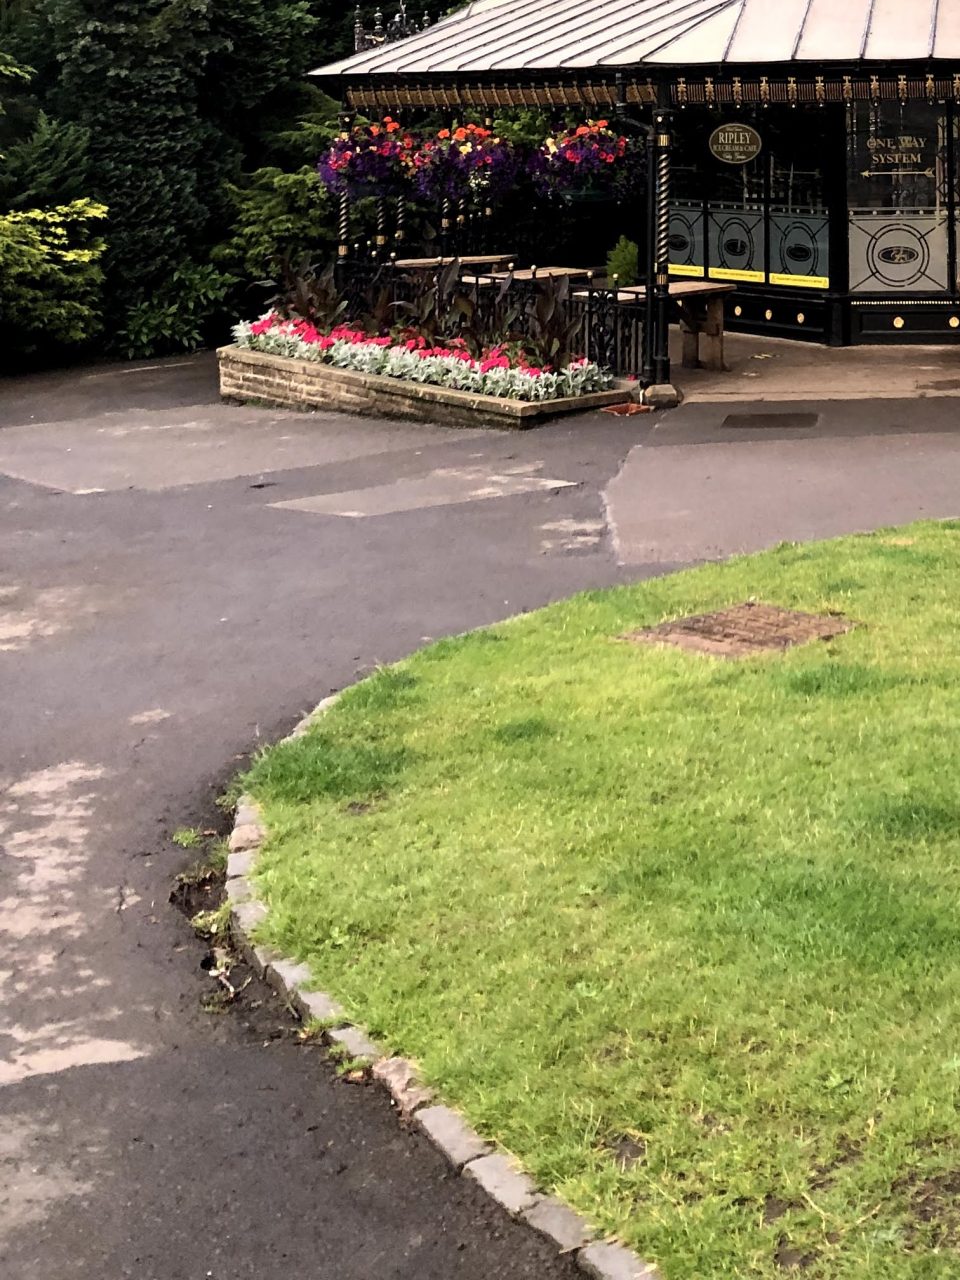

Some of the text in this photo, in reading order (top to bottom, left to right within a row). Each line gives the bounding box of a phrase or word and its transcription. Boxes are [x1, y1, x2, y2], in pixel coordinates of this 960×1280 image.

[718, 132, 751, 144] RIPLEY
[866, 136, 927, 149] ONE WAY
[872, 153, 922, 164] SYSTEM
